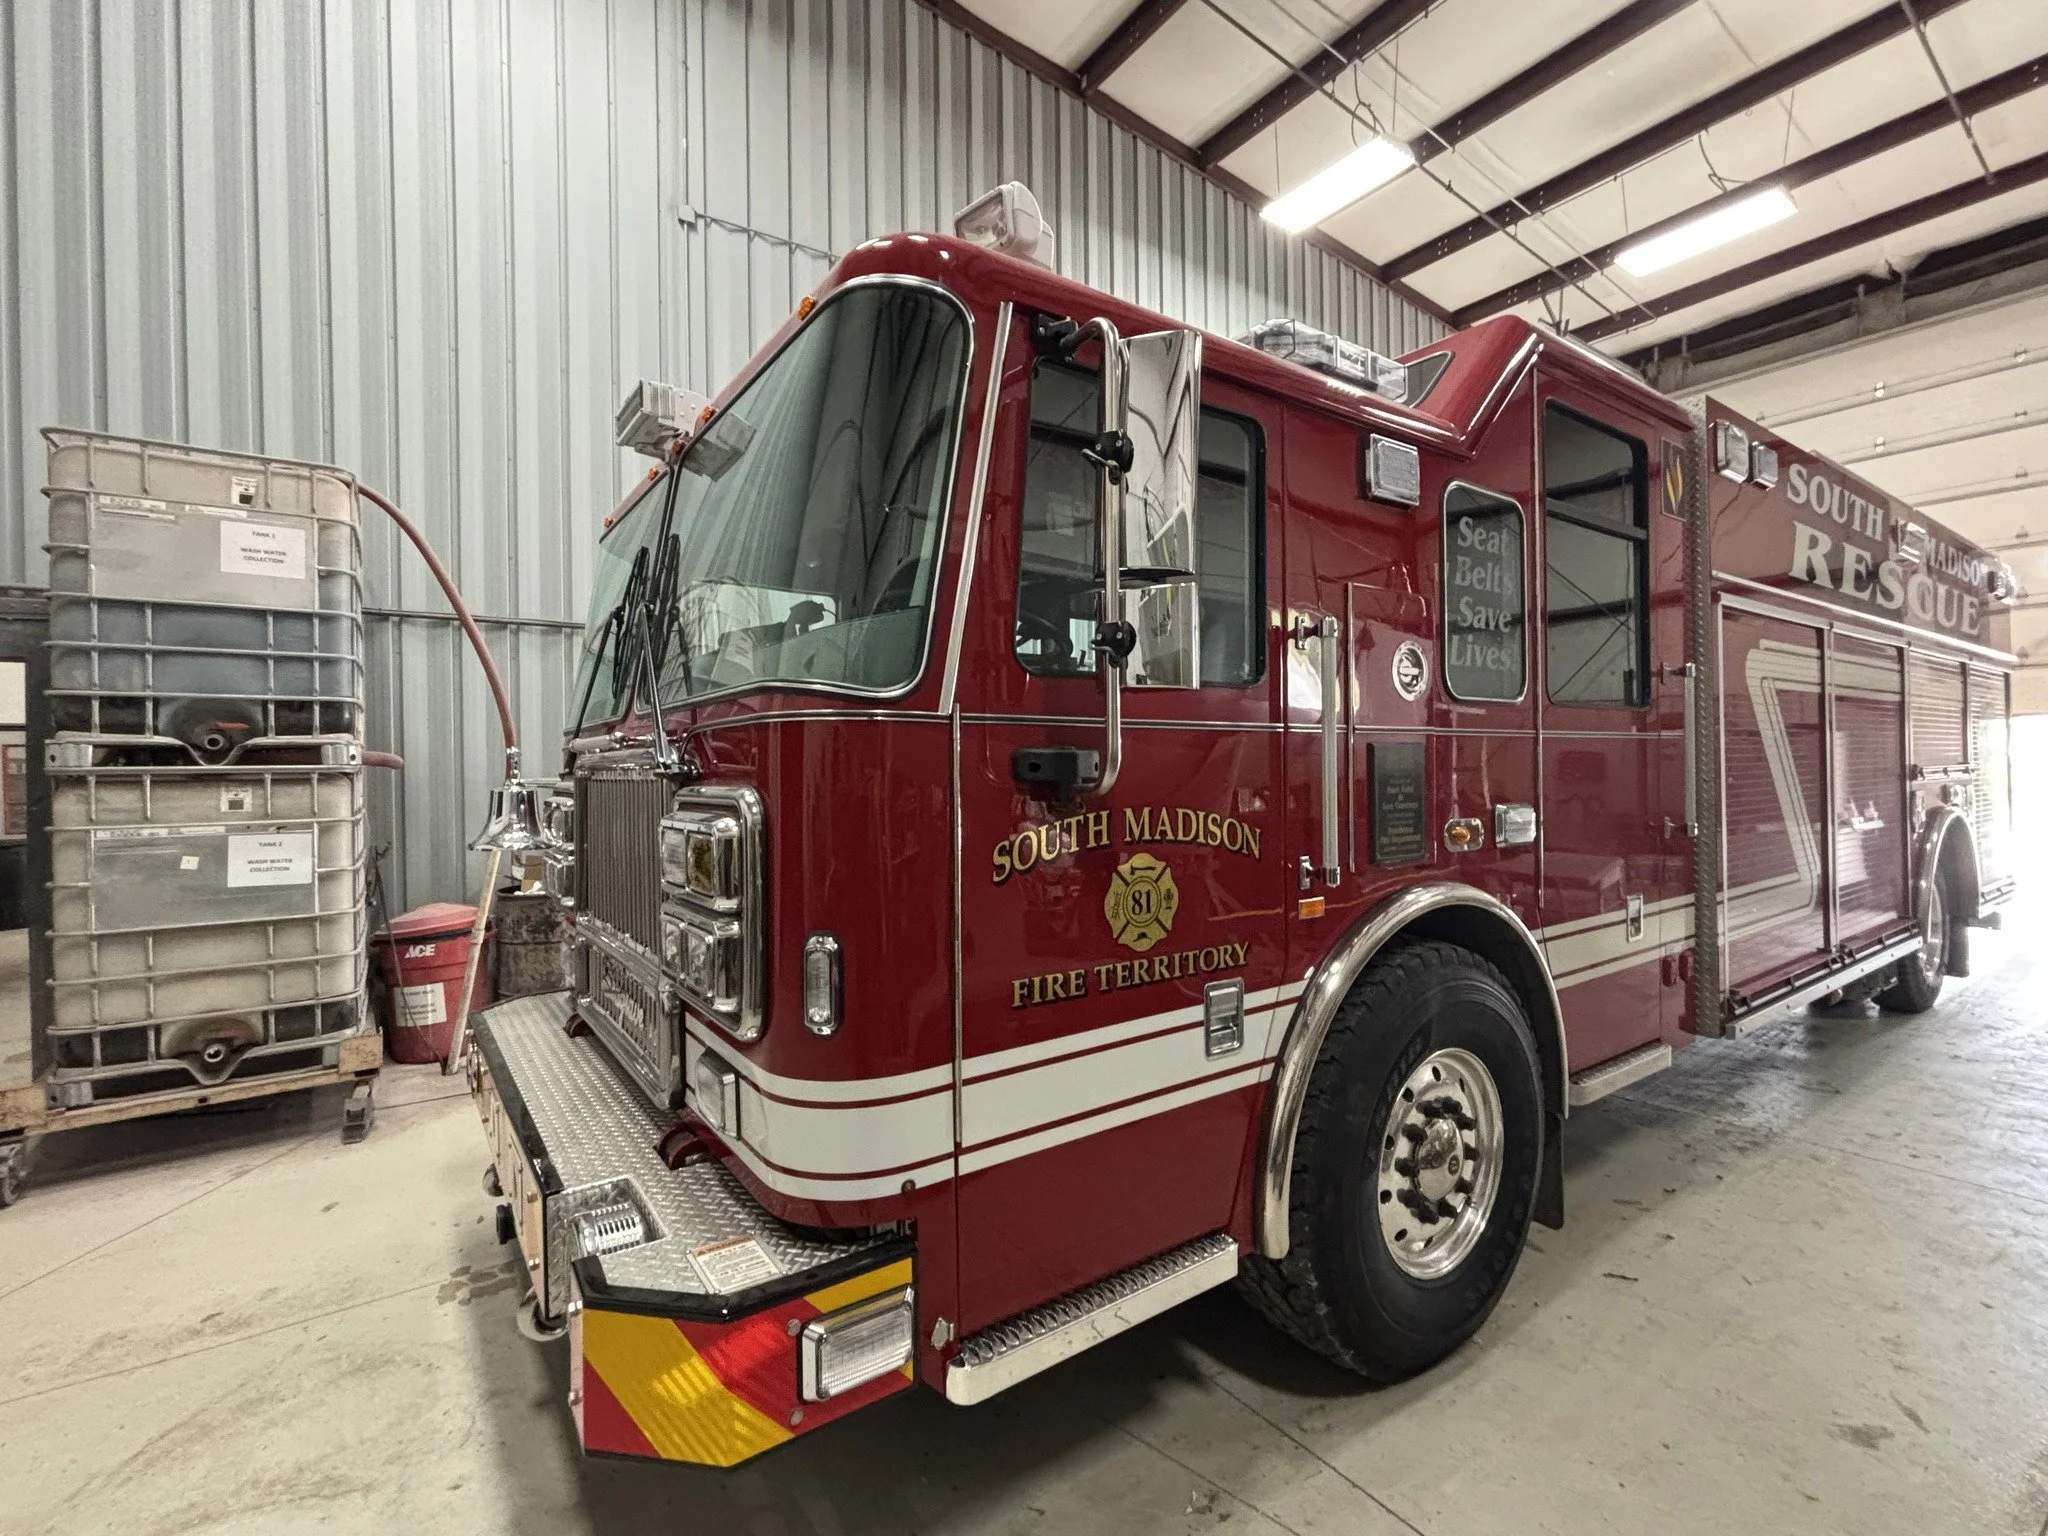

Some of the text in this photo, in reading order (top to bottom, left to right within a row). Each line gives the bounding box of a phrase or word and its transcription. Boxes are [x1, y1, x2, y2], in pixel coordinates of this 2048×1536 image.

[1457, 516, 1509, 556] Seat
[1787, 463, 1984, 588] SOUTH MADISO
[243, 555, 285, 564] COLLECTION
[1455, 555, 1515, 597] Belts
[1789, 520, 1982, 636] RESCUE
[1459, 596, 1512, 633] Save
[993, 806, 1261, 883] SOUTH MADISON
[1131, 889, 1152, 916] 81
[405, 944, 437, 958] ACE
[1011, 941, 1250, 1008] FIRE TERRITORY
